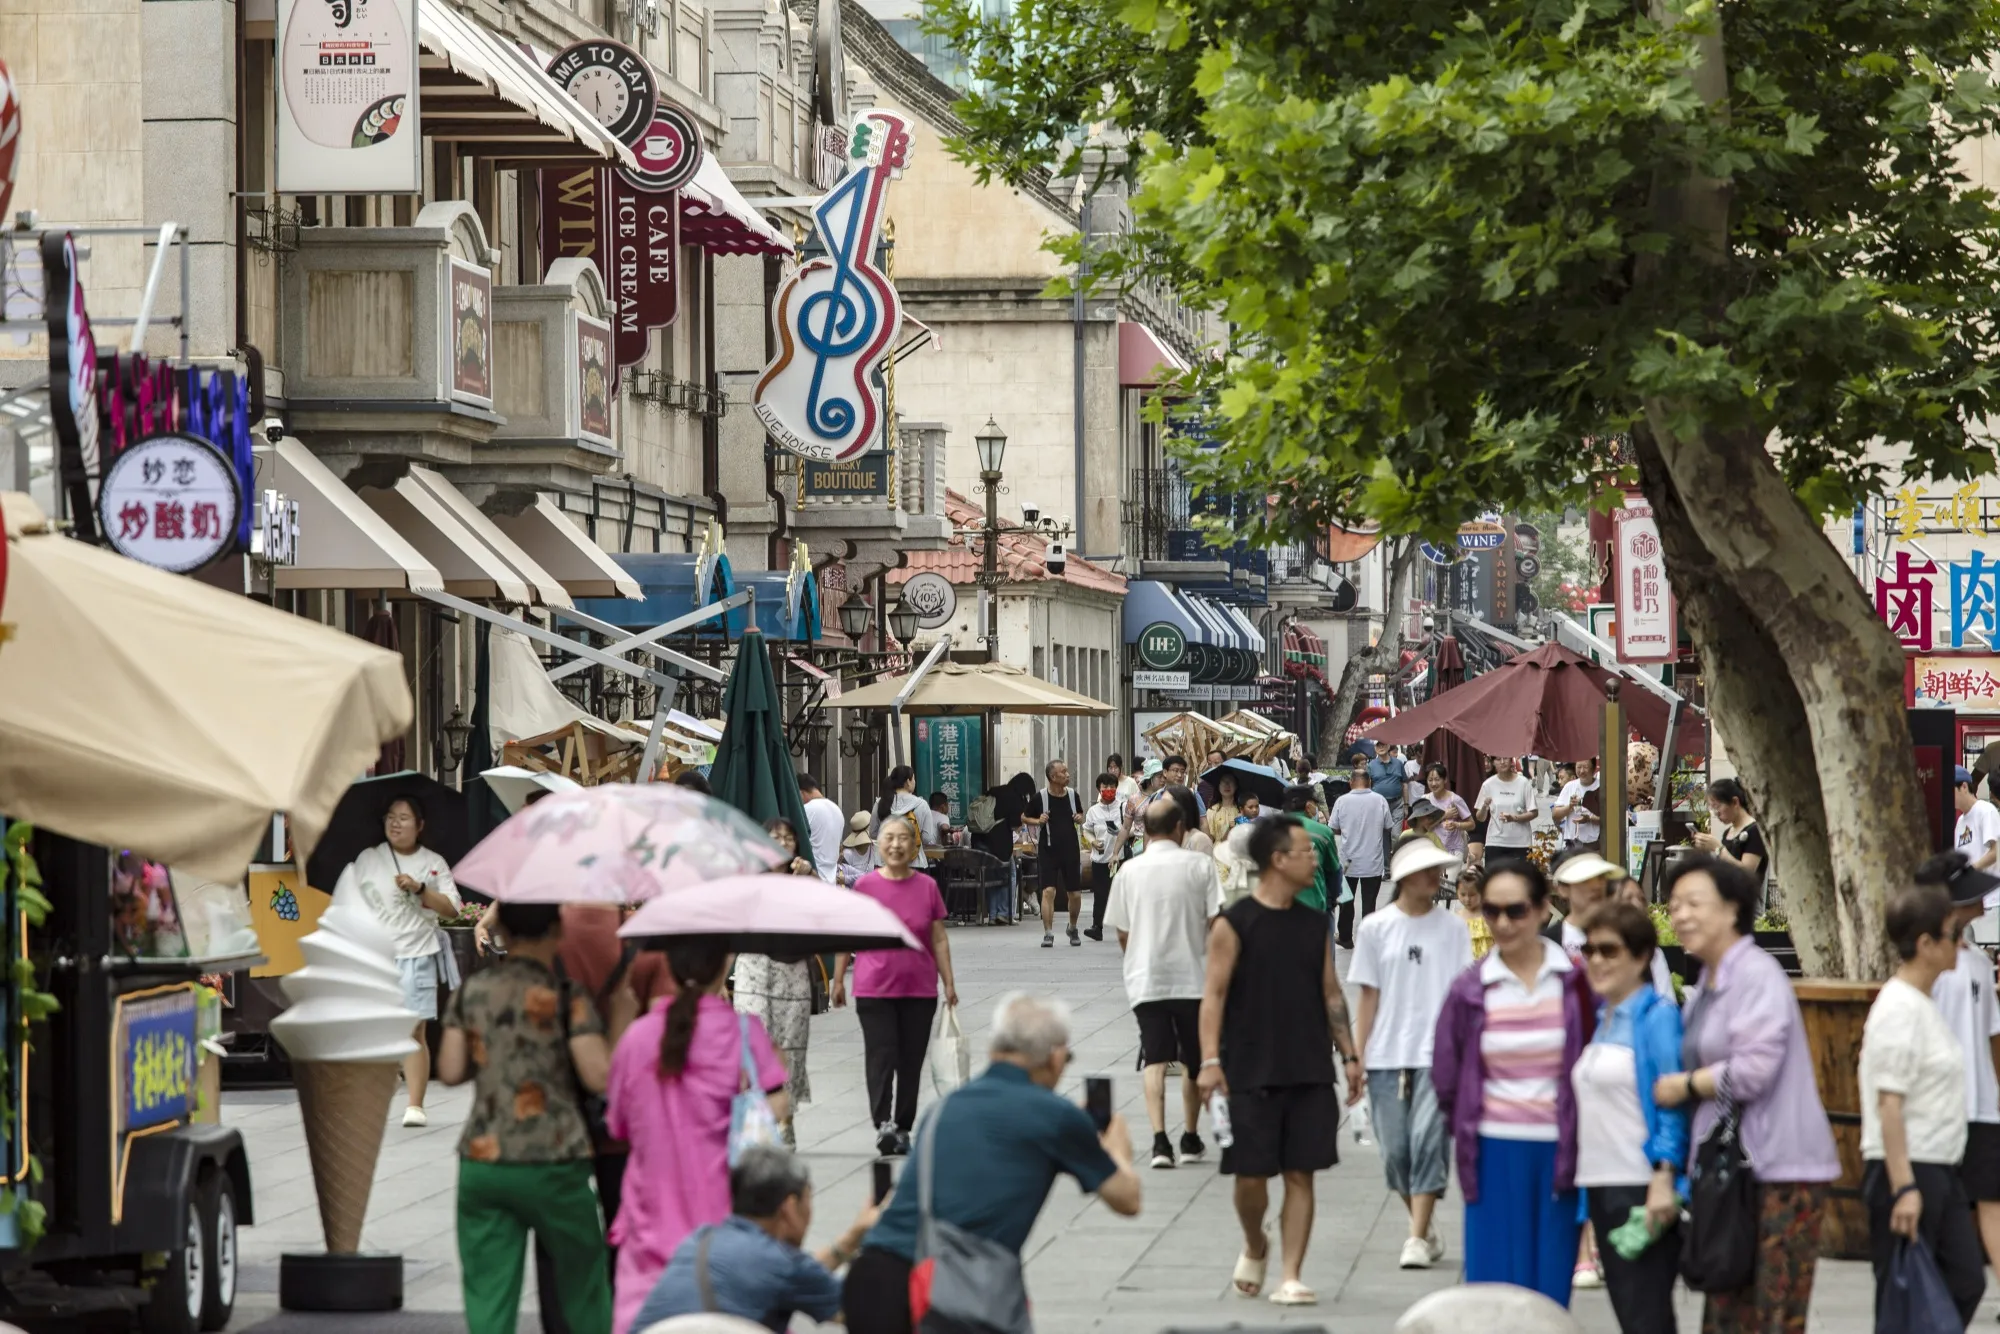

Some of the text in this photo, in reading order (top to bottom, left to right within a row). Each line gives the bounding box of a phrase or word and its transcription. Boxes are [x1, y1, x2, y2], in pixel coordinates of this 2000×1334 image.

[588, 47, 615, 63] TO
[619, 57, 647, 94] EAT
[619, 196, 638, 333] ICE CREAM
[648, 205, 669, 284] CAFE
[757, 403, 831, 458] LIVE HOUSE
[814, 472, 876, 489] BOUTIQUE
[117, 500, 221, 540] 炒酸奶
[1461, 534, 1497, 547] WINE
[1875, 549, 2000, 652] 卤肉
[1922, 668, 2000, 700] 朝鲜冷
[1252, 706, 1273, 714] BAR
